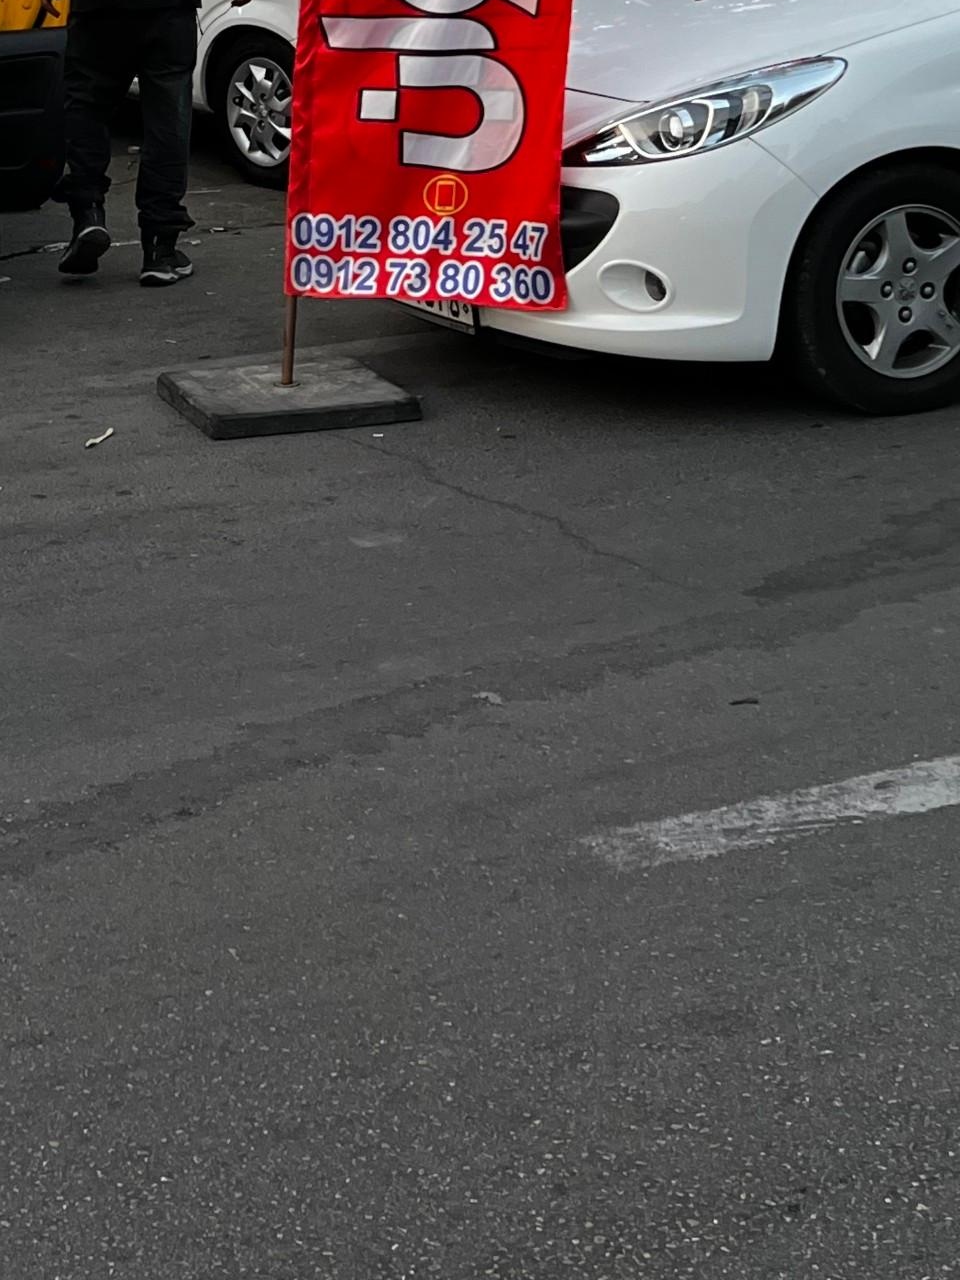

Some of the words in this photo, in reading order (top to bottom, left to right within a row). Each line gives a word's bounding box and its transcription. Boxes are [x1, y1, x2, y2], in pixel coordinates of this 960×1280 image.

[293, 212, 381, 252] 0912
[388, 216, 455, 254] 804
[462, 218, 507, 259] 25
[511, 220, 548, 261] 47
[292, 253, 379, 294] 0912
[386, 259, 431, 296] 73
[436, 260, 484, 299] 80
[490, 263, 555, 304] 360
